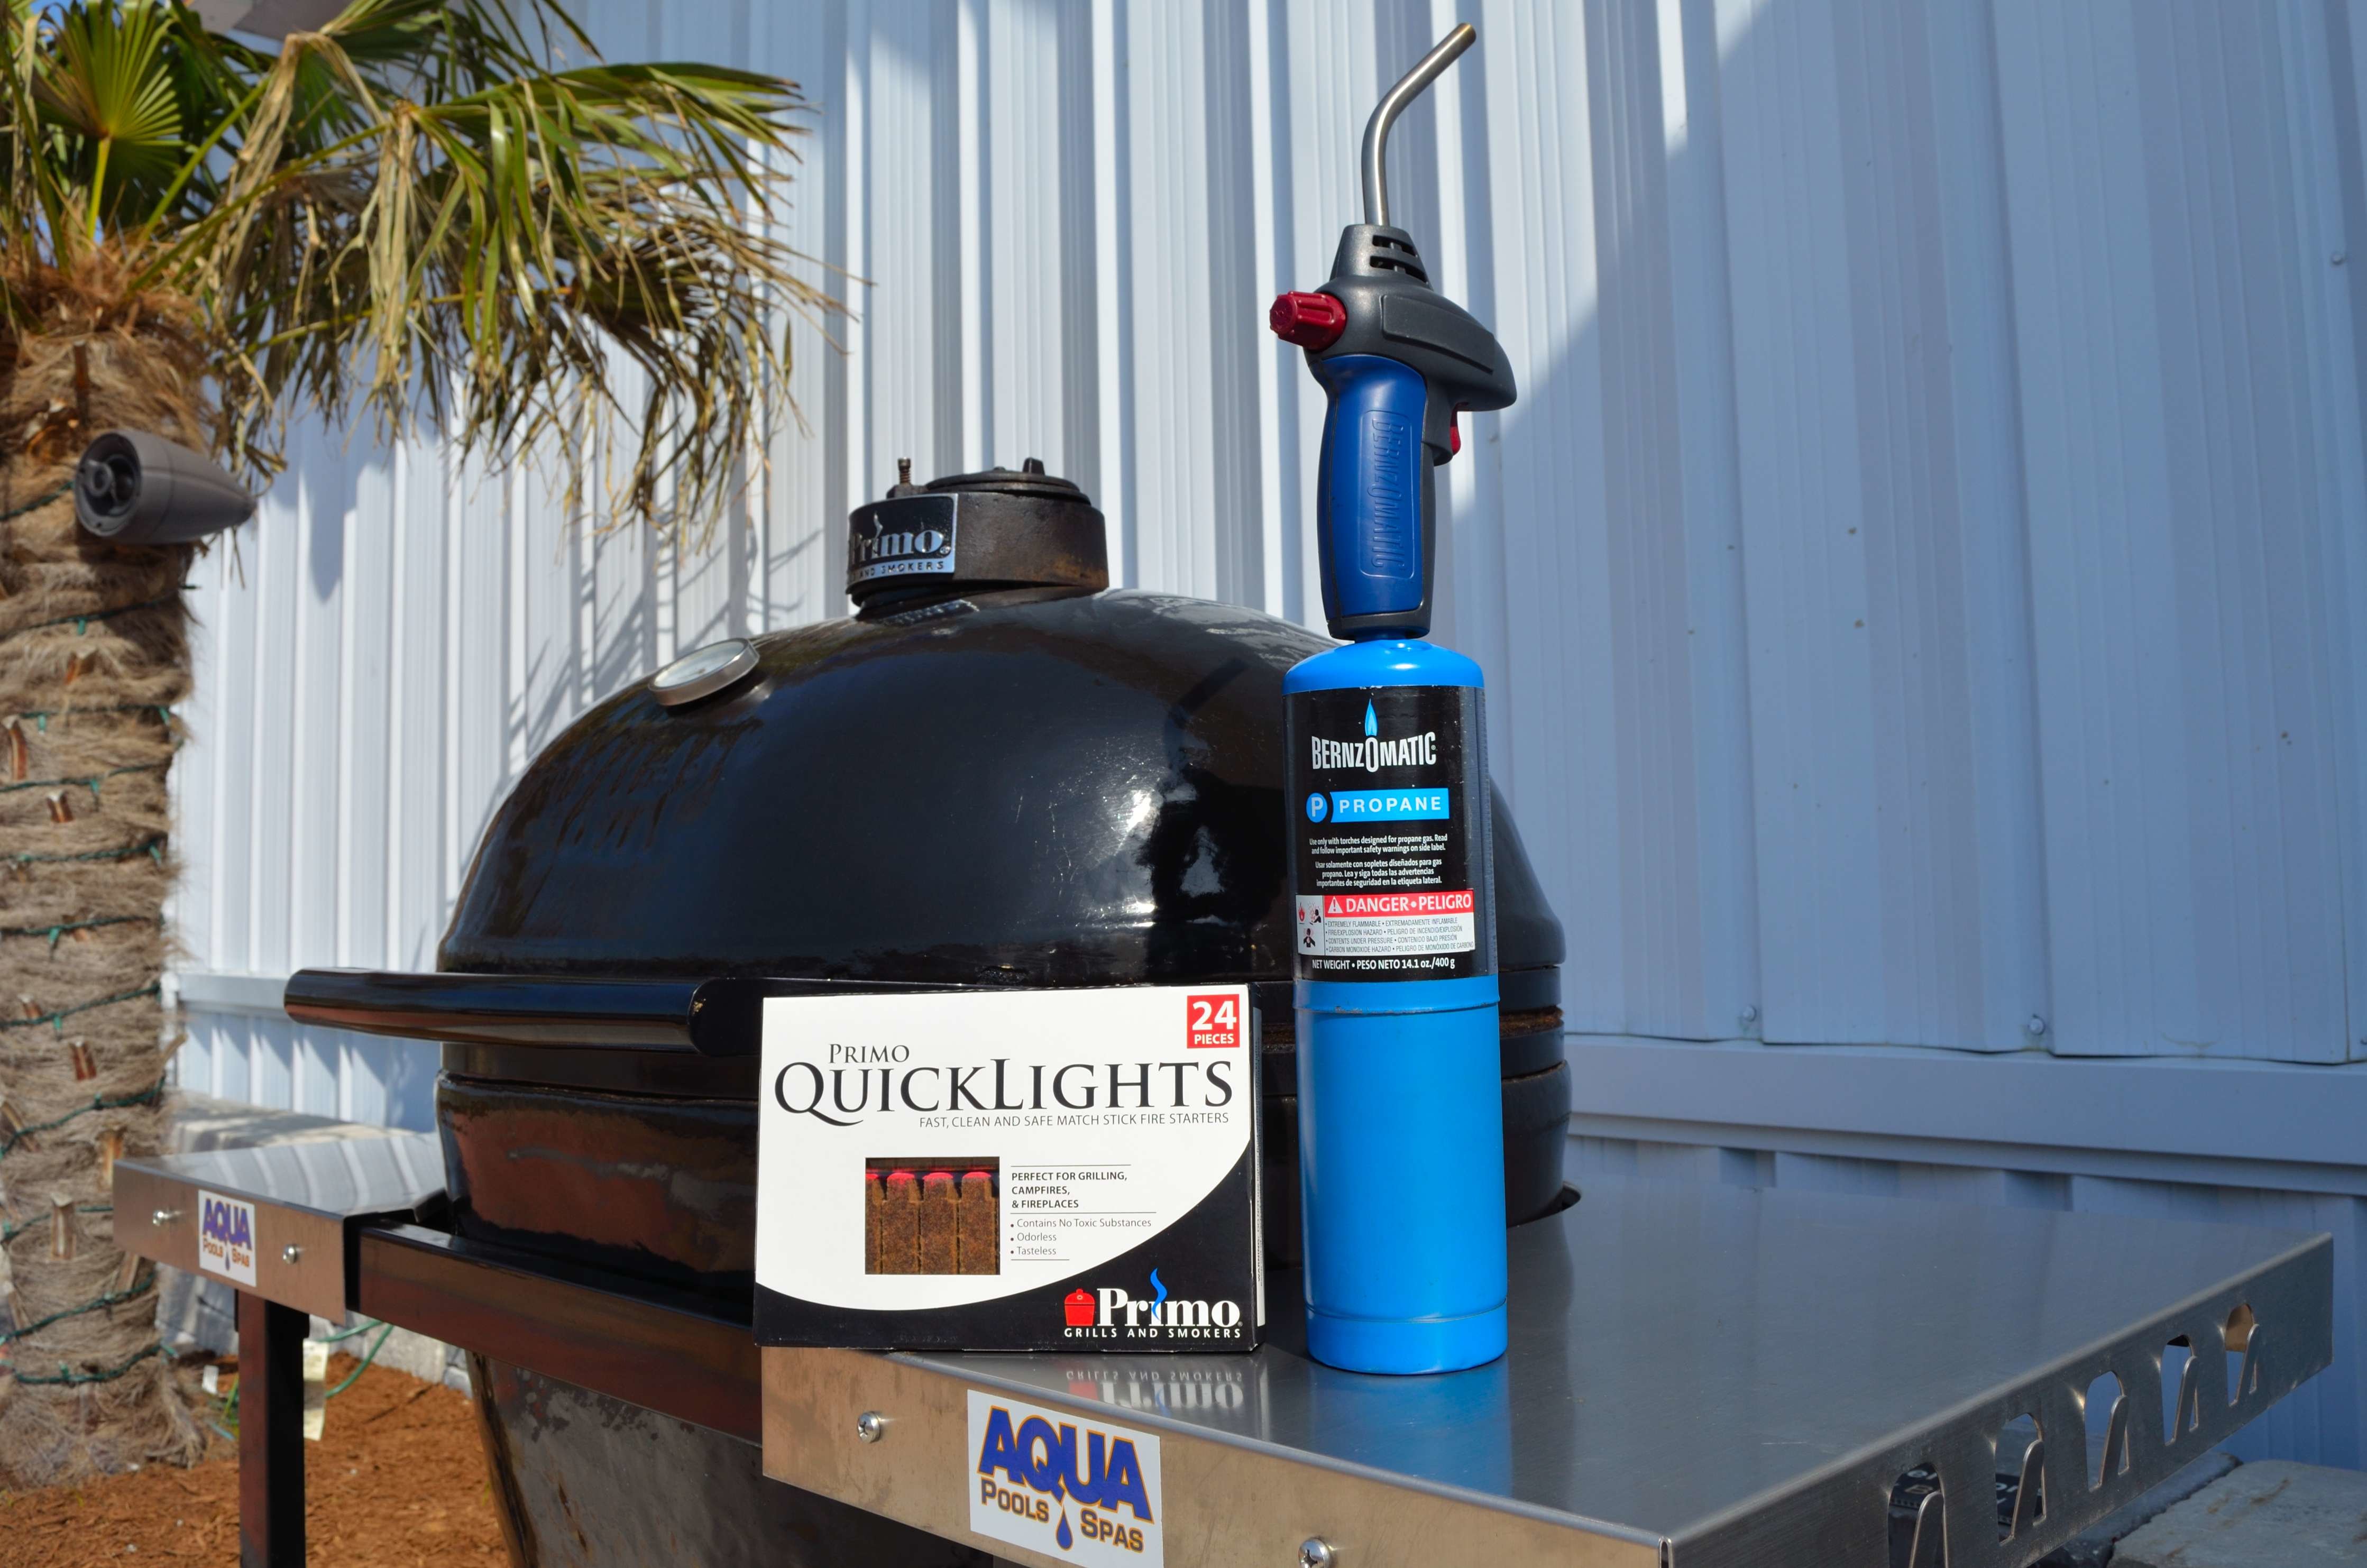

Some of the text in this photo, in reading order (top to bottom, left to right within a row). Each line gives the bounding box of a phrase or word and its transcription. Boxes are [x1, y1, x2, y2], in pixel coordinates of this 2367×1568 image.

[1367, 419, 1405, 570] BERNZOMATIC
[882, 561, 944, 574] SMOKERS
[1311, 732, 1437, 773] BERNZOMATIC
[1311, 796, 1441, 817] P PROPANE
[1318, 838, 1327, 846] only
[1361, 836, 1387, 846] designed
[1398, 836, 1421, 846] propane
[1336, 846, 1362, 856] important
[1364, 845, 1381, 855] safety
[1382, 845, 1410, 854] warnings
[1364, 860, 1388, 869] sopletes
[1389, 858, 1418, 867] diseñados
[1359, 869, 1370, 878] siga
[1317, 879, 1344, 888] importantes
[1354, 877, 1381, 888] seguridad
[1398, 877, 1422, 886] etiqueta
[1346, 894, 1471, 912] DANGER PELIGRO
[1313, 957, 1455, 969] NET WEIGHT PESO NETO 14.1 oz./400 g
[1192, 1001, 1237, 1031] 24
[1194, 1033, 1234, 1045] PIECES
[829, 1044, 910, 1063] PRIMO
[920, 1112, 1228, 1129] FAST, CLEAN AND SAFE MATCH STICK FIRE STARTERS
[1056, 1172, 1076, 1180] FOR
[1079, 1171, 1127, 1181] GRILLING,
[1012, 1186, 1070, 1195] CAMPFIRES,
[203, 1198, 252, 1252] AQUA
[1017, 1218, 1152, 1227] Contains No Toxic Substances
[1017, 1233, 1057, 1241] Odorless
[1016, 1246, 1056, 1255] Tasteless
[1097, 1280, 1240, 1327] Primo
[1065, 1328, 1241, 1338] GRILLS AND SMOKERS
[977, 1405, 1154, 1524] AQUA
[981, 1475, 1144, 1553] POOLS SPAS
